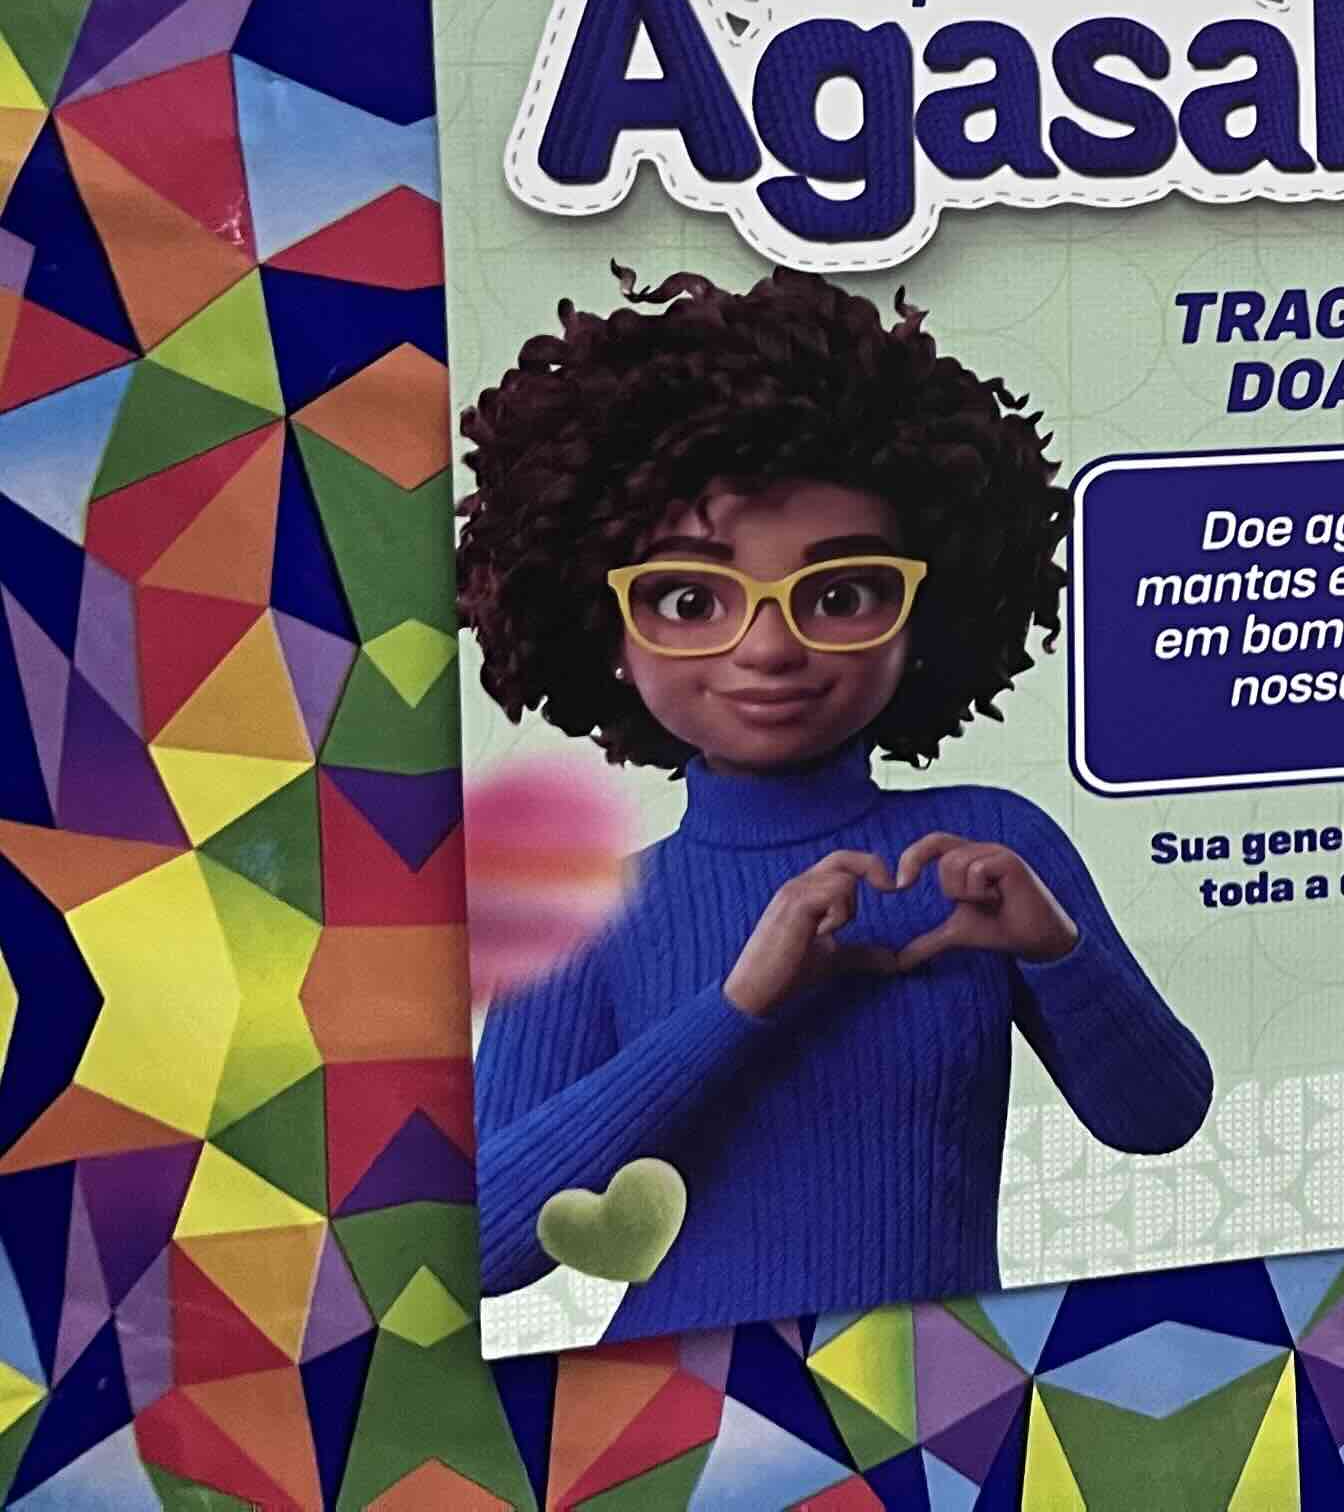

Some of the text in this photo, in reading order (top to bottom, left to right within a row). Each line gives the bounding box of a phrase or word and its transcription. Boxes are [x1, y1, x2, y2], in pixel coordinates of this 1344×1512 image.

[1202, 508, 1294, 551] Doe
[1135, 563, 1317, 607] mantas
[1154, 624, 1229, 659] em
[1242, 613, 1344, 656] bom
[1150, 830, 1230, 865] Sua
[1200, 872, 1294, 910] toda
[1305, 875, 1329, 900] a
